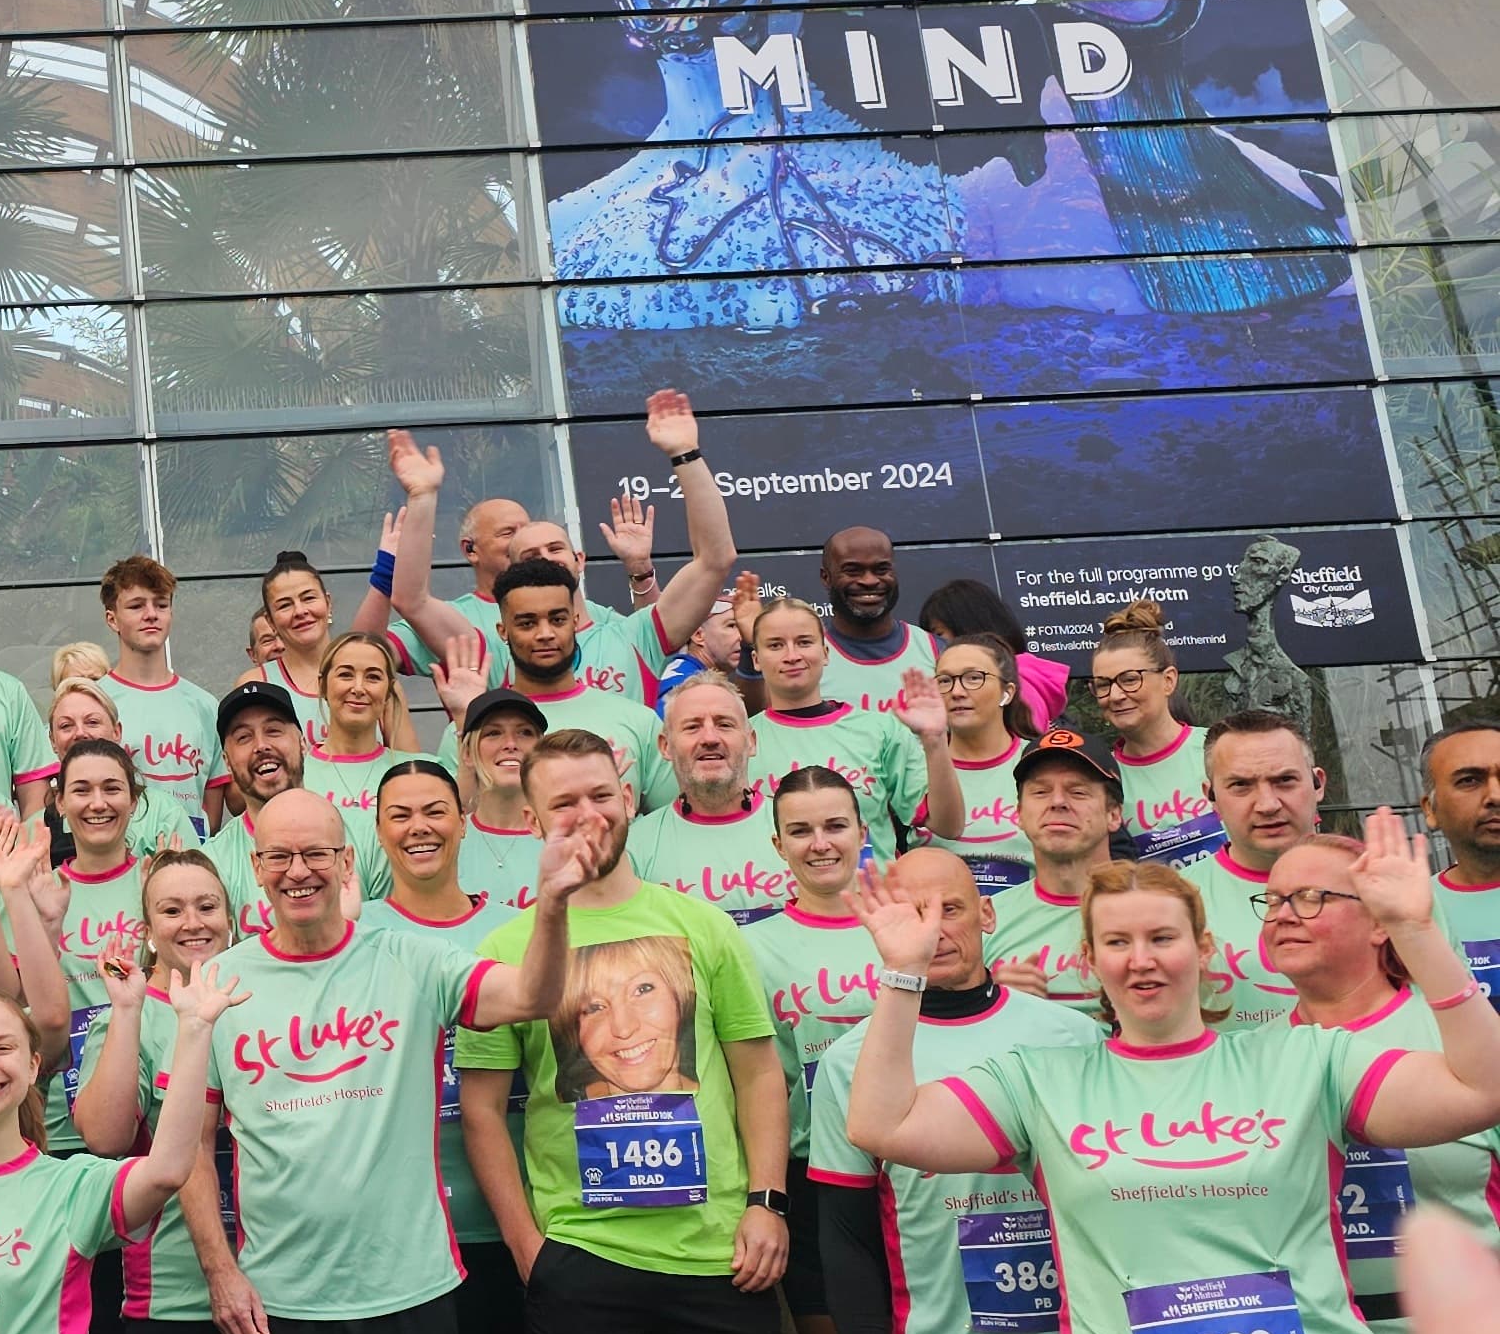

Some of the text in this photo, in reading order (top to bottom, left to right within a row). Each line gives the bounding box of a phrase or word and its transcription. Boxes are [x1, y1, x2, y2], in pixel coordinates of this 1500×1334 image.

[712, 22, 1133, 115] MIND
[714, 462, 954, 501] September 2024
[1015, 569, 1043, 586] For
[1047, 568, 1072, 585] the
[1074, 567, 1103, 584] full
[1106, 565, 1199, 584] programme
[1202, 565, 1223, 582] go
[1290, 566, 1363, 584] Sheffield
[1019, 586, 1190, 609] sheffield.ac.uk/fotm
[1302, 582, 1355, 595] City Council
[1038, 624, 1094, 636] FOTM2024
[80, 910, 146, 947] Luke
[1473, 955, 1491, 966] 10K
[233, 1006, 400, 1085] St Luke's
[264, 1084, 384, 1114] Sheffield's Hospice
[615, 1111, 660, 1123] SHEFFIELD
[1069, 1101, 1287, 1170] St Luke's
[605, 1138, 683, 1169] 1486
[1348, 1151, 1371, 1162] 10K
[629, 1174, 665, 1186] BRAD
[944, 1190, 1018, 1210] Sheffield's
[1111, 1182, 1269, 1203] Sheffield's Hospice
[1004, 1228, 1052, 1242] SHEFFIELD
[1190, 1280, 1227, 1293] Sheffield
[1193, 1290, 1224, 1301] Mutual
[1034, 1297, 1053, 1309] PB
[1180, 1294, 1263, 1314] SHEFFIELD 10K
